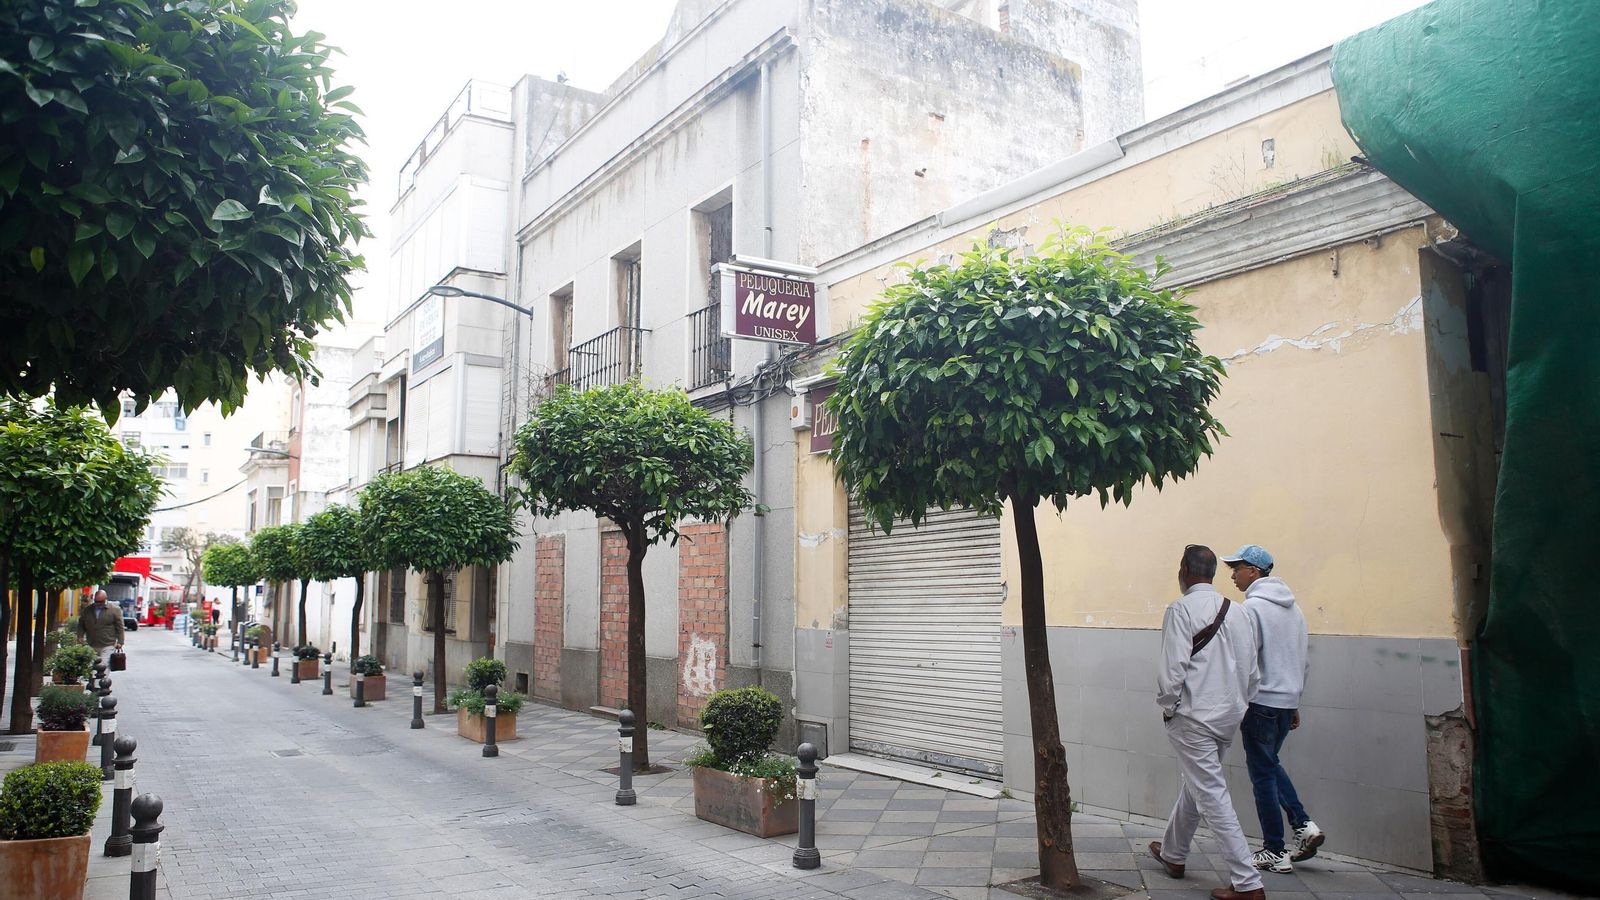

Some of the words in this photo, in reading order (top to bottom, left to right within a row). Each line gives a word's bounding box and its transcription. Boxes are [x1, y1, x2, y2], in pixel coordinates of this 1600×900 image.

[740, 273, 810, 297] PELUQUERIA
[741, 290, 810, 329] Marey
[754, 326, 799, 341] UNISEX
